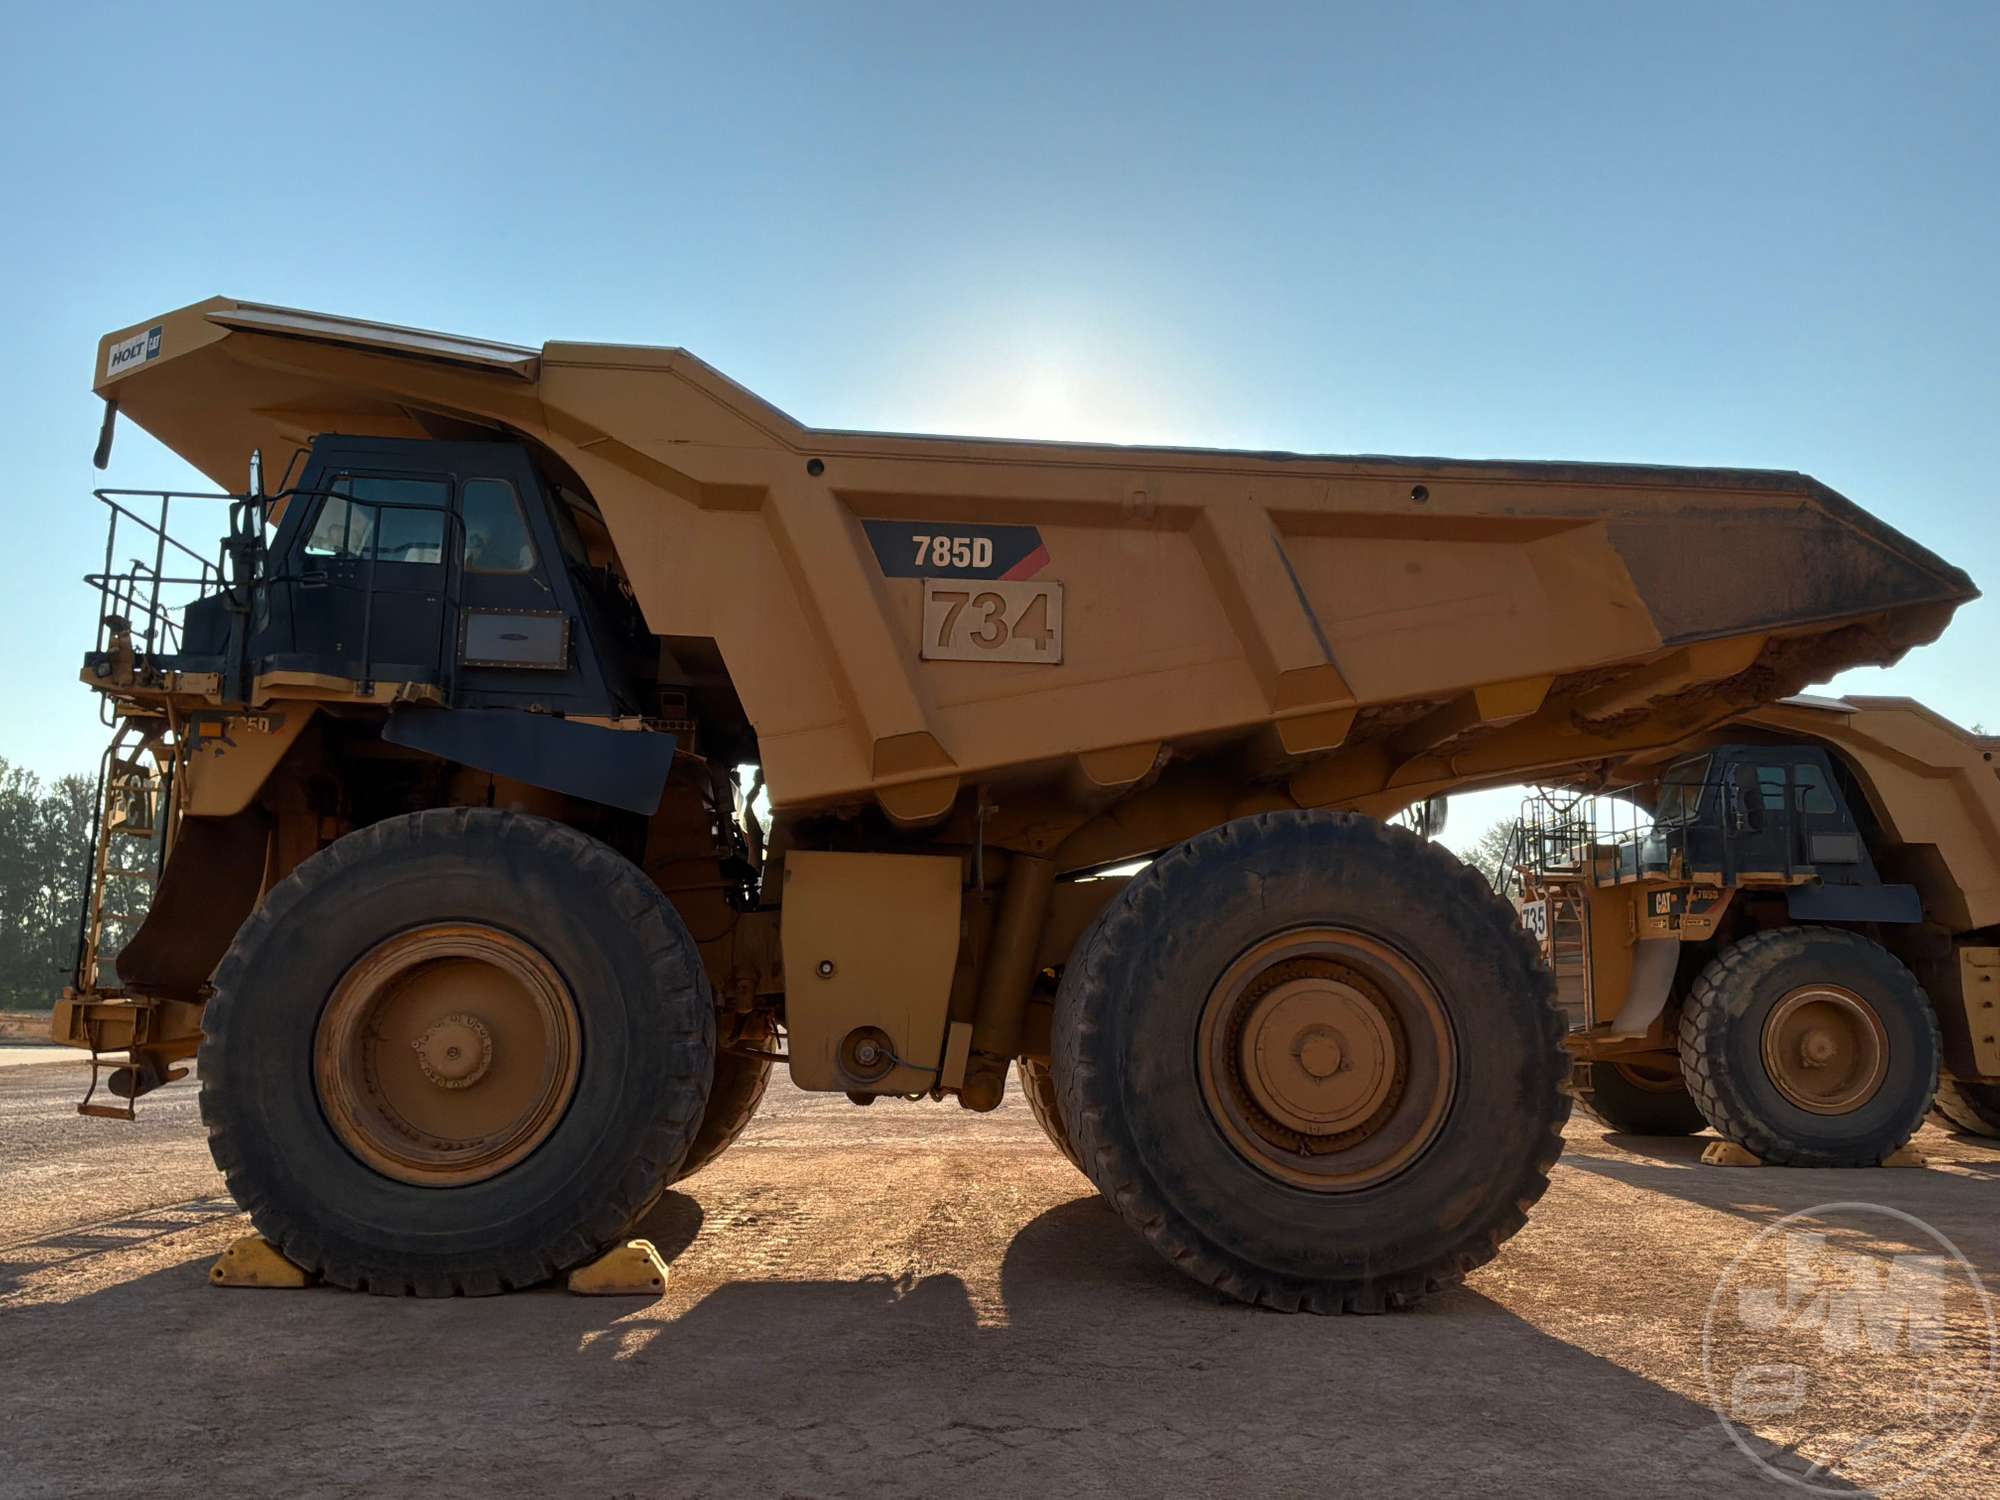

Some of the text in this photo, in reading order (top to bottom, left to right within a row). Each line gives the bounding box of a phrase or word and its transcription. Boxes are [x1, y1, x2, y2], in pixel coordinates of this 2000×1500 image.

[111, 342, 145, 367] HOLT
[912, 535, 993, 568] 785D
[931, 591, 1055, 651] 734
[1655, 892, 1671, 914] CAT
[1523, 906, 1545, 934] 735
